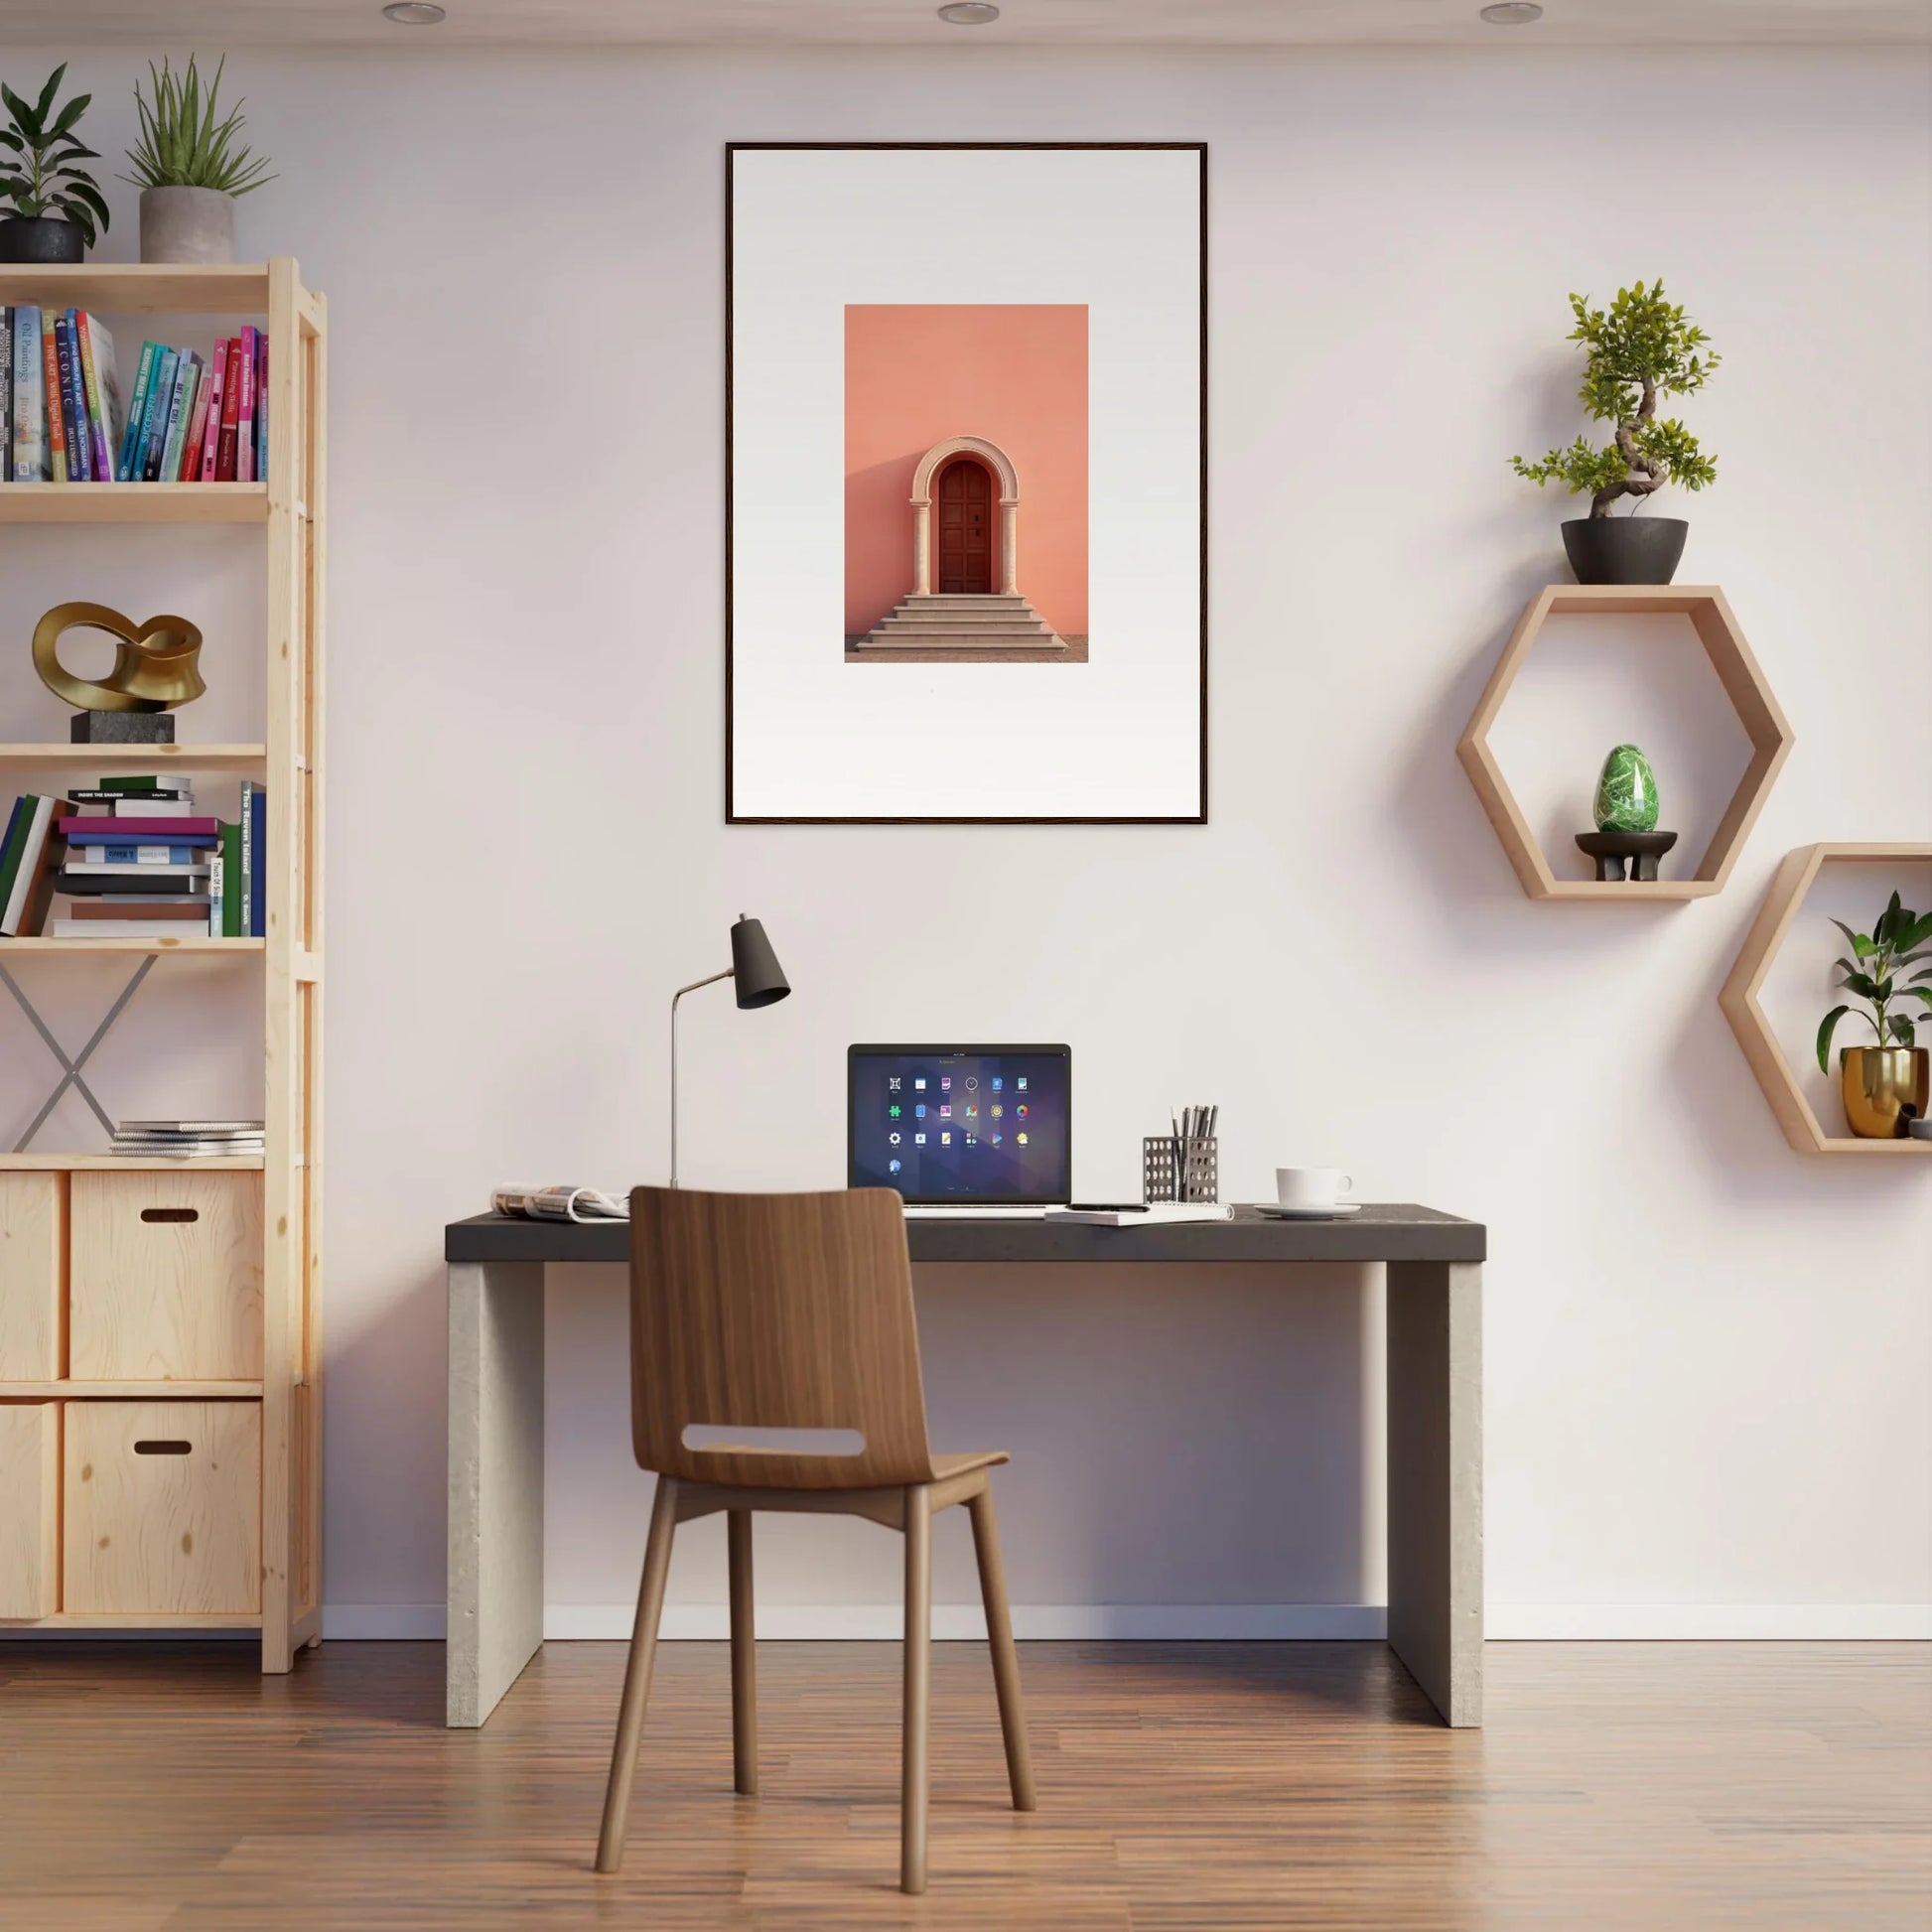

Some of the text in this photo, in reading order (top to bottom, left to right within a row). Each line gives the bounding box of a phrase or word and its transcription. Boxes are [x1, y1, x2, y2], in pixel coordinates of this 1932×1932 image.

[19, 323, 33, 382] Oil Paintings
[47, 345, 56, 361] FINE
[59, 342, 73, 406] ICONIC
[86, 372, 97, 409] Portraits
[227, 360, 238, 413] Parenting Skills
[50, 400, 60, 422] Digital
[53, 423, 62, 439] Tools
